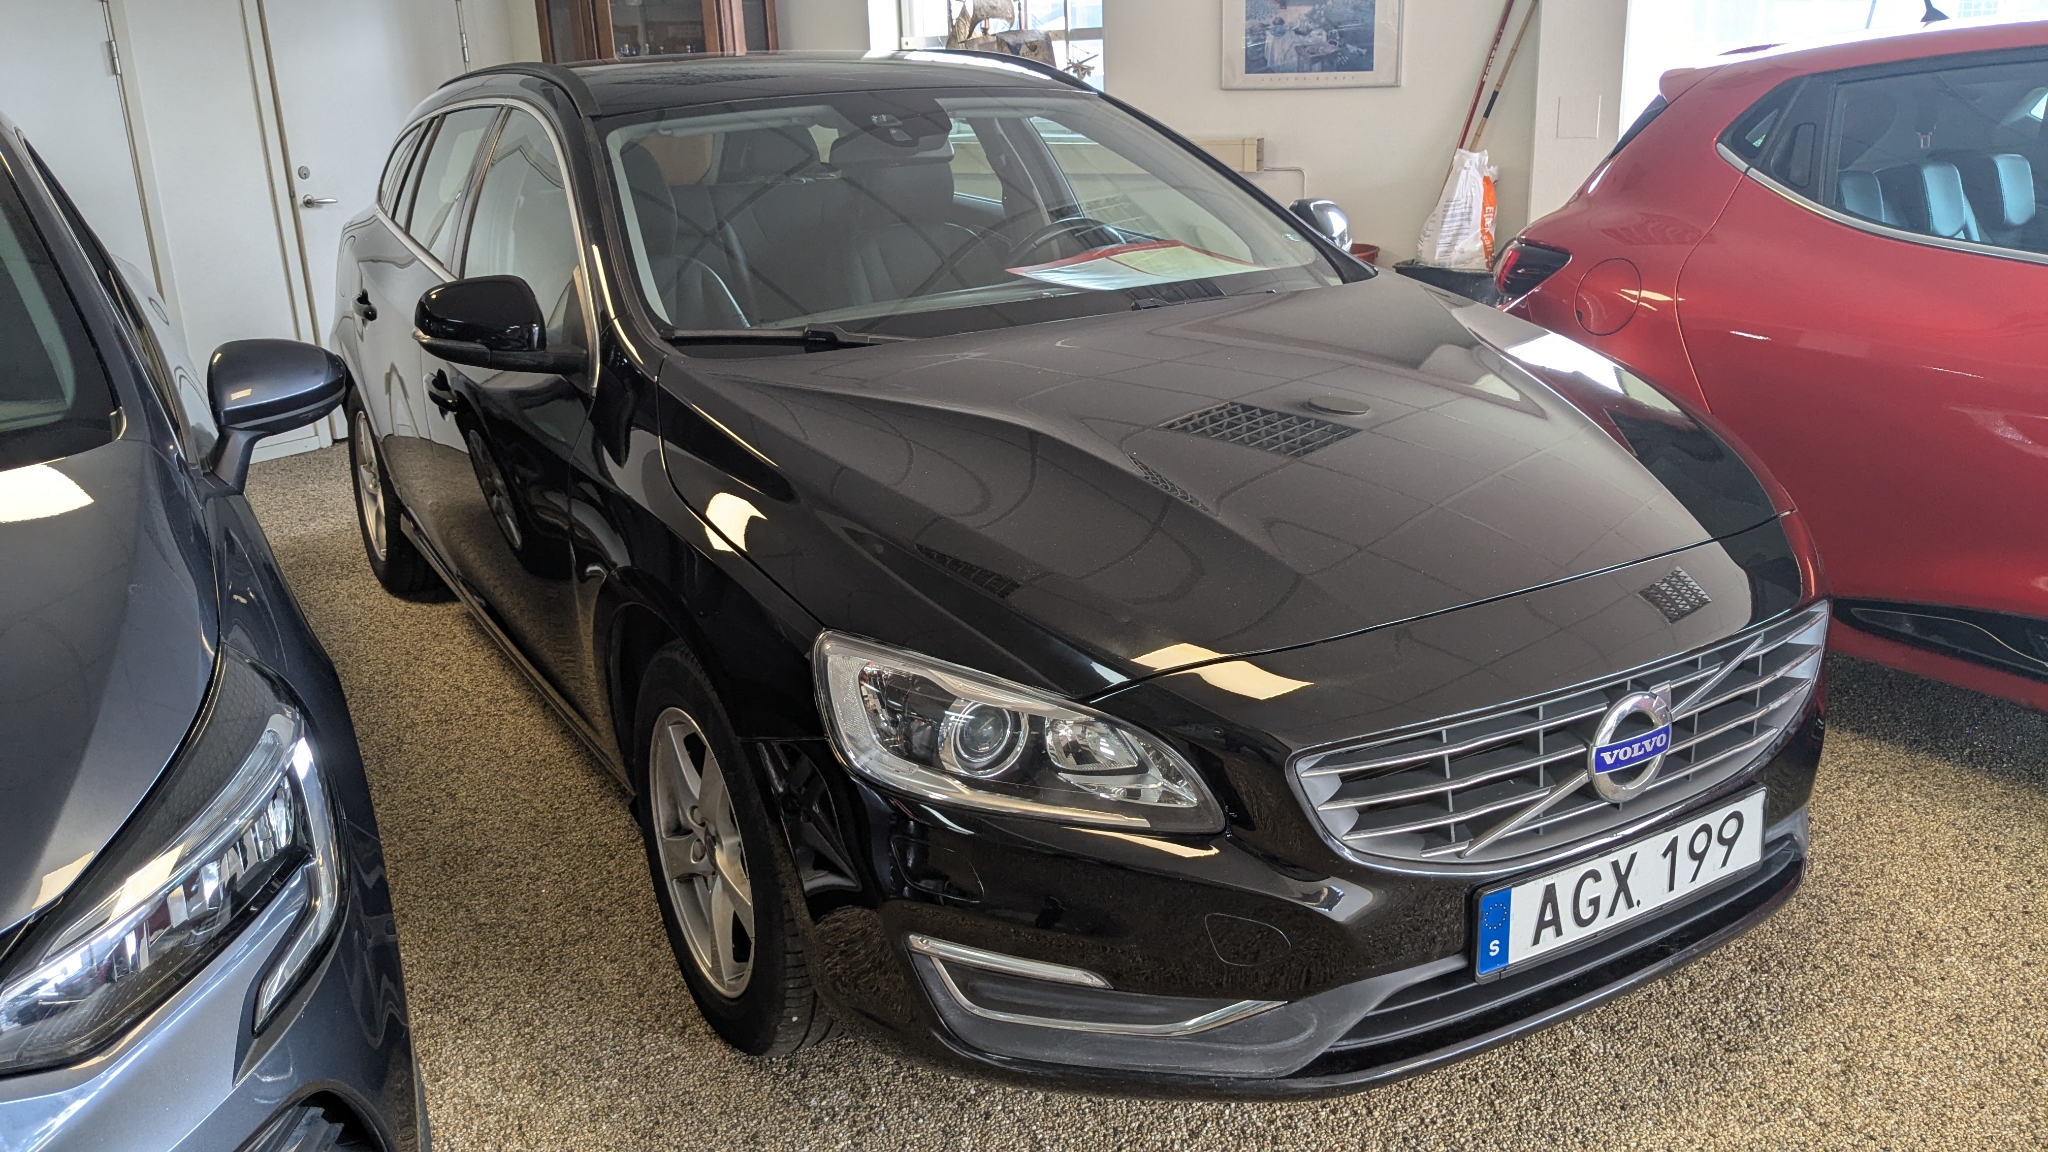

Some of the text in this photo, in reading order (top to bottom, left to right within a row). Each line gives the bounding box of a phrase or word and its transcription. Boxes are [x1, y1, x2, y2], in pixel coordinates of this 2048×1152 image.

[1600, 733, 1667, 766] VOLVO
[1660, 810, 1745, 893] 199
[1488, 939, 1501, 957] S
